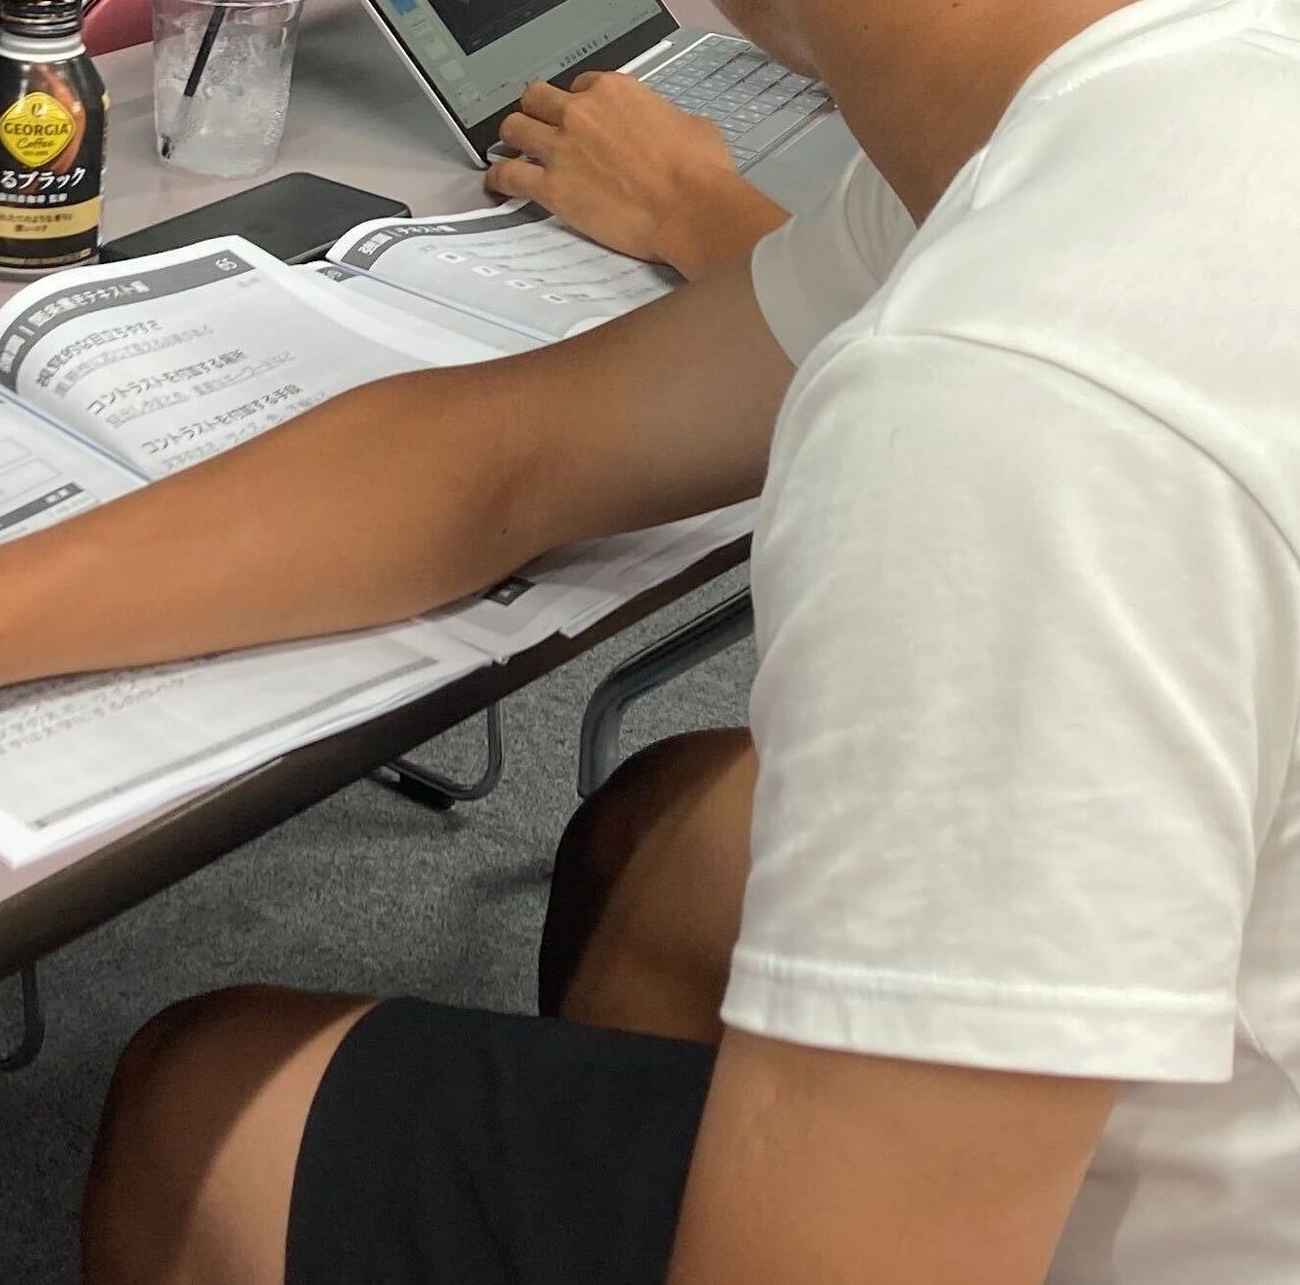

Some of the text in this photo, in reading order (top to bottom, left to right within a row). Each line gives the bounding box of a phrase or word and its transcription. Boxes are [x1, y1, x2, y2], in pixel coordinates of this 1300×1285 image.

[4, 122, 70, 136] GEORGIA
[16, 138, 55, 149] Coffee
[37, 320, 163, 387] 視覚的な目立ちやすさ
